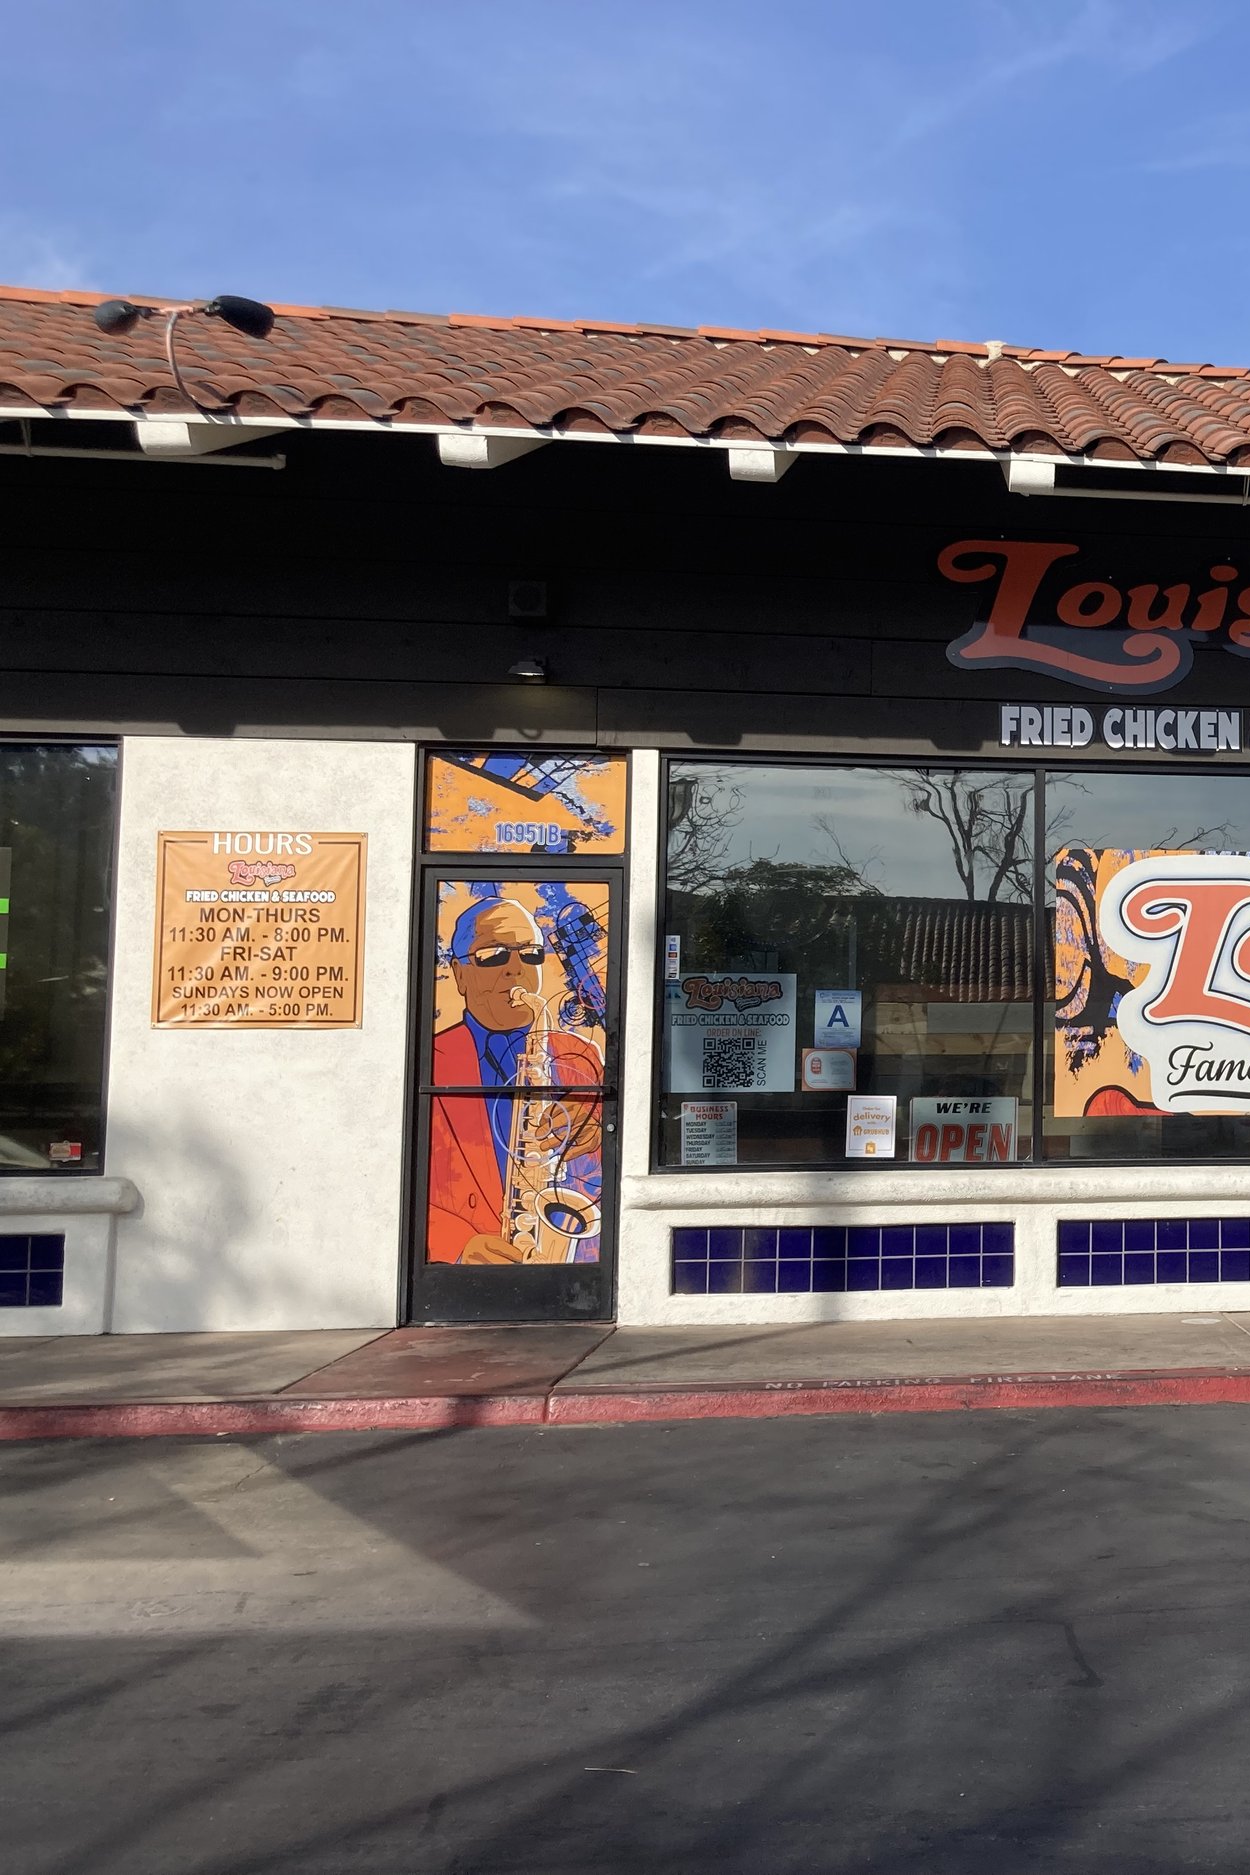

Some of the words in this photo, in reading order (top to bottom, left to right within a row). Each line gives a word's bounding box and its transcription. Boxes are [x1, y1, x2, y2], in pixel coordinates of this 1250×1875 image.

[1001, 704, 1093, 746] FRIED
[1103, 707, 1240, 750] CHICKEN
[213, 832, 313, 855] HOURS
[228, 860, 296, 886] Louisiana
[186, 890, 218, 903] FRIED
[220, 890, 269, 903] CHICKEN
[271, 891, 281, 903] &
[282, 891, 336, 903] SEAFOOD
[199, 908, 321, 923] MON-THURS
[169, 927, 216, 942] 11:30
[221, 928, 256, 942] AM.
[273, 928, 311, 942] 8:00
[316, 928, 350, 943] PM.
[220, 946, 297, 961] FRI-SAT
[168, 966, 214, 981] 11:30
[220, 966, 254, 981] AM.
[272, 966, 310, 981] 9:00
[315, 967, 349, 981] PM.
[172, 986, 250, 999] SUNDAYS
[255, 986, 294, 999] NOW
[298, 986, 344, 999] OPEN
[682, 976, 784, 1012] Louisiana
[180, 1003, 221, 1016] 11:30
[224, 1003, 253, 1016] AM.
[268, 1003, 301, 1017] 5:00
[305, 1004, 333, 1017] PM.
[827, 1004, 850, 1028] A
[671, 1014, 698, 1027] FRIED
[700, 1014, 737, 1027] CHICKEN
[738, 1014, 747, 1027] &
[748, 1014, 790, 1027] SEAFOOD
[707, 1028, 730, 1037] ORDER
[732, 1028, 743, 1037] ON
[757, 1040, 768, 1055] ME
[757, 1058, 767, 1087] SCAN
[690, 1105, 729, 1113] BUSINESS
[936, 1102, 992, 1114] WE'RE
[853, 1111, 891, 1123] delivery
[915, 1123, 1013, 1161] OPEN
[822, 1377, 942, 1388] PARKING
[1051, 1373, 1123, 1381] LANE
